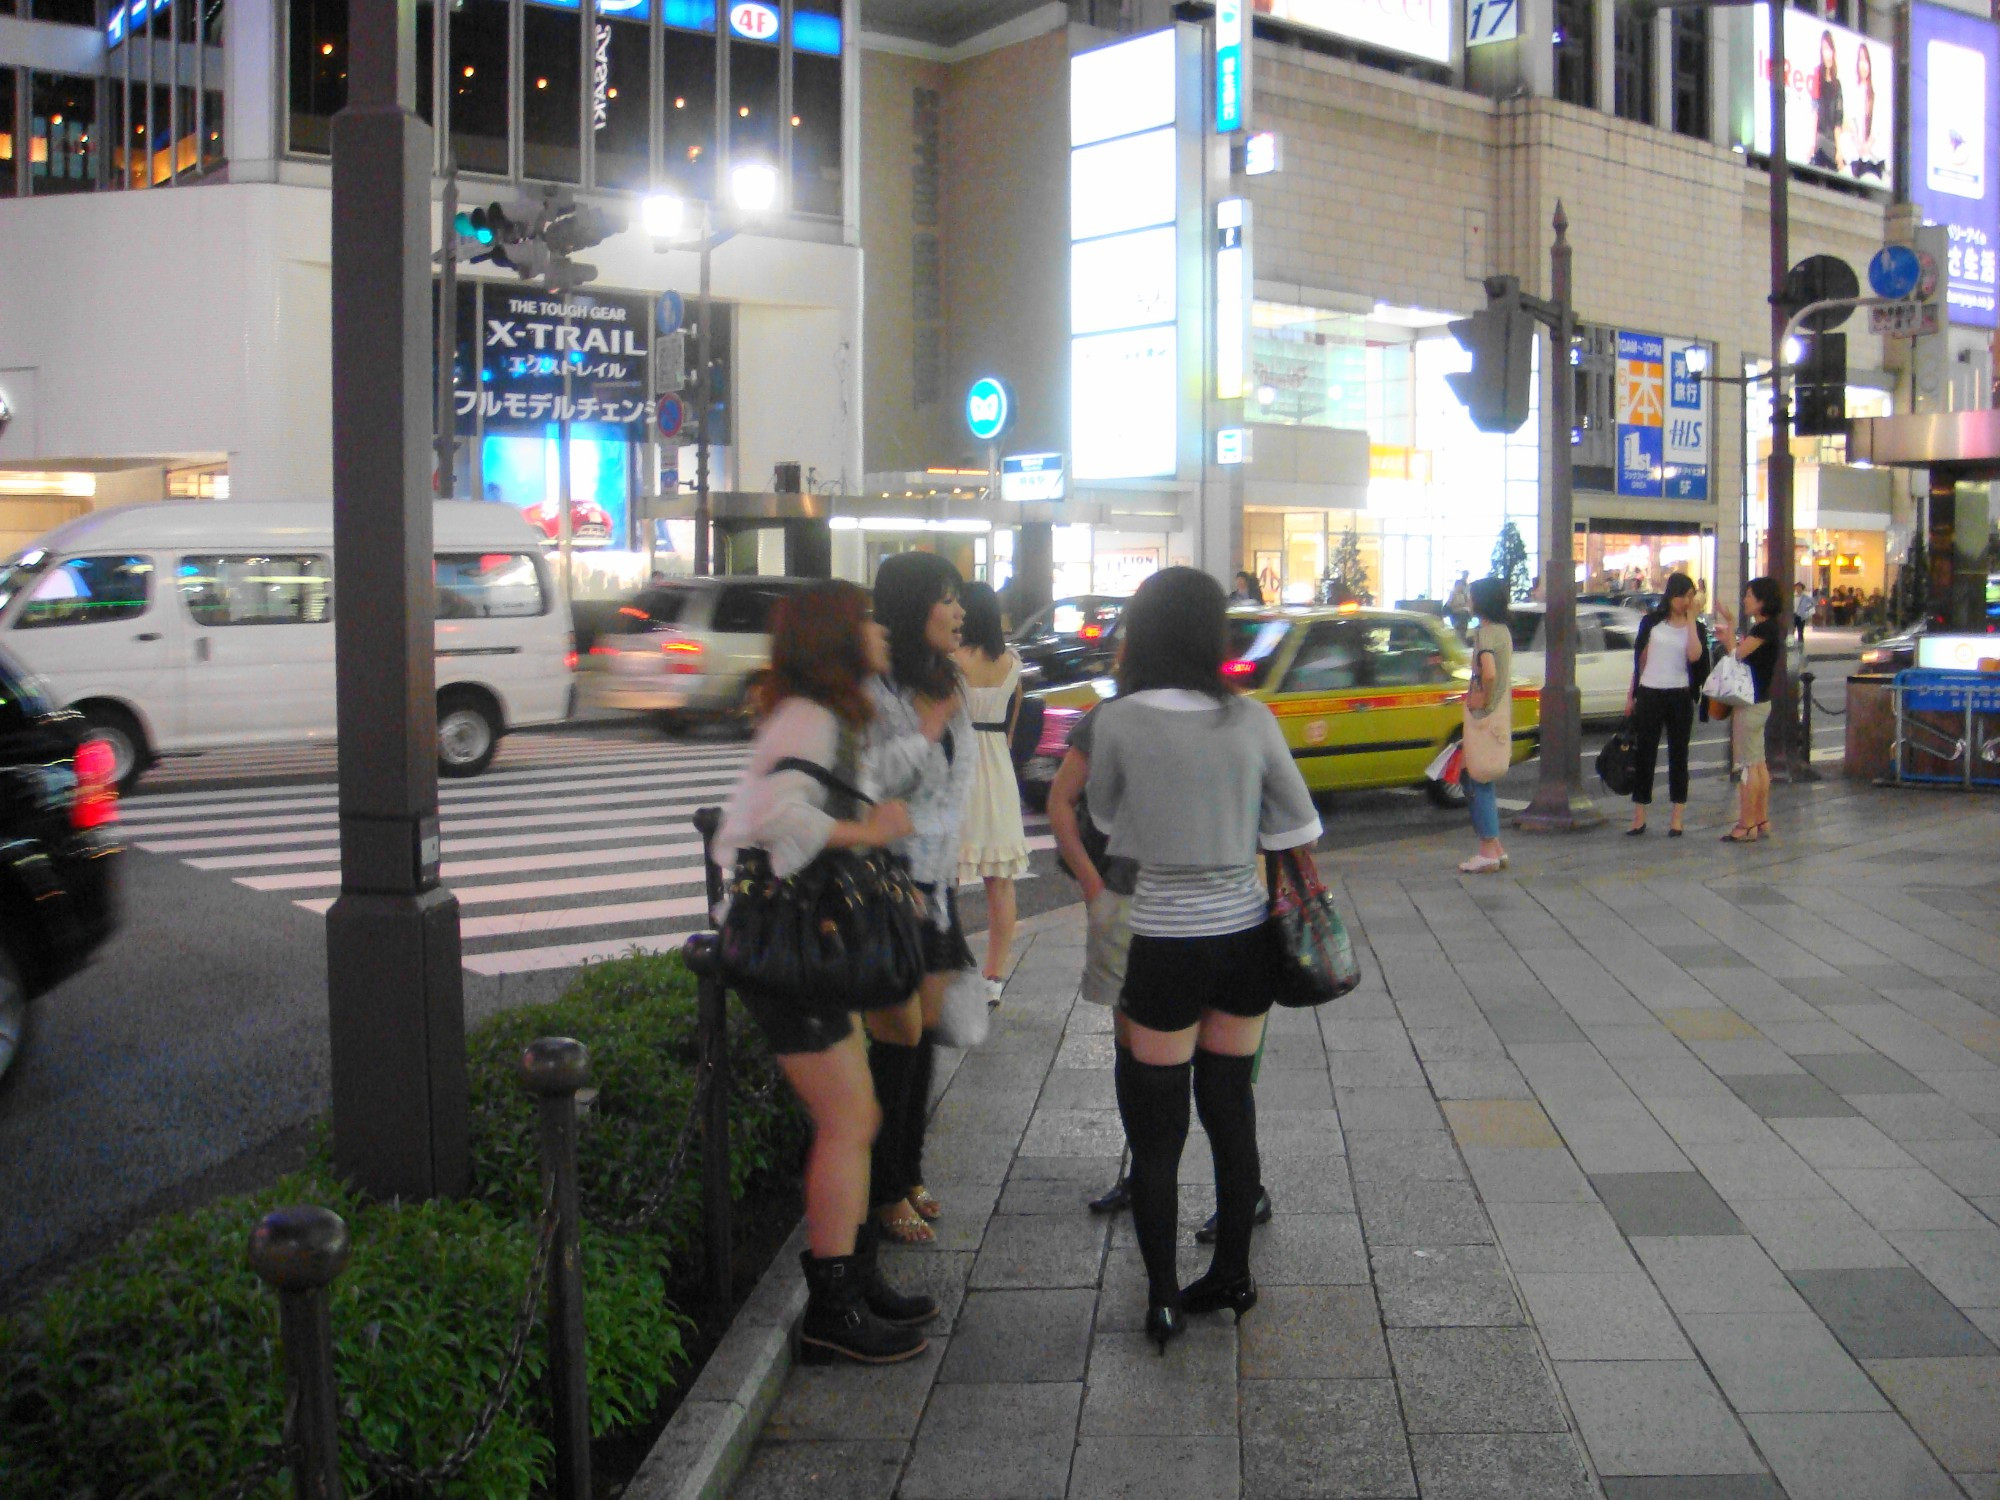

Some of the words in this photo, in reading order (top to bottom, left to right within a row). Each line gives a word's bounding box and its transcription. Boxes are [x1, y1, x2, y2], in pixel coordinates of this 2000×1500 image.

[738, 9, 767, 33] 4F
[1469, 0, 1514, 40] 17
[509, 299, 537, 316] THE
[540, 301, 587, 319] TOUGH
[590, 304, 627, 321] GEAR
[486, 319, 648, 357] X-TRAIL
[509, 355, 627, 379] エクストレイル
[1669, 418, 1703, 448] HIS
